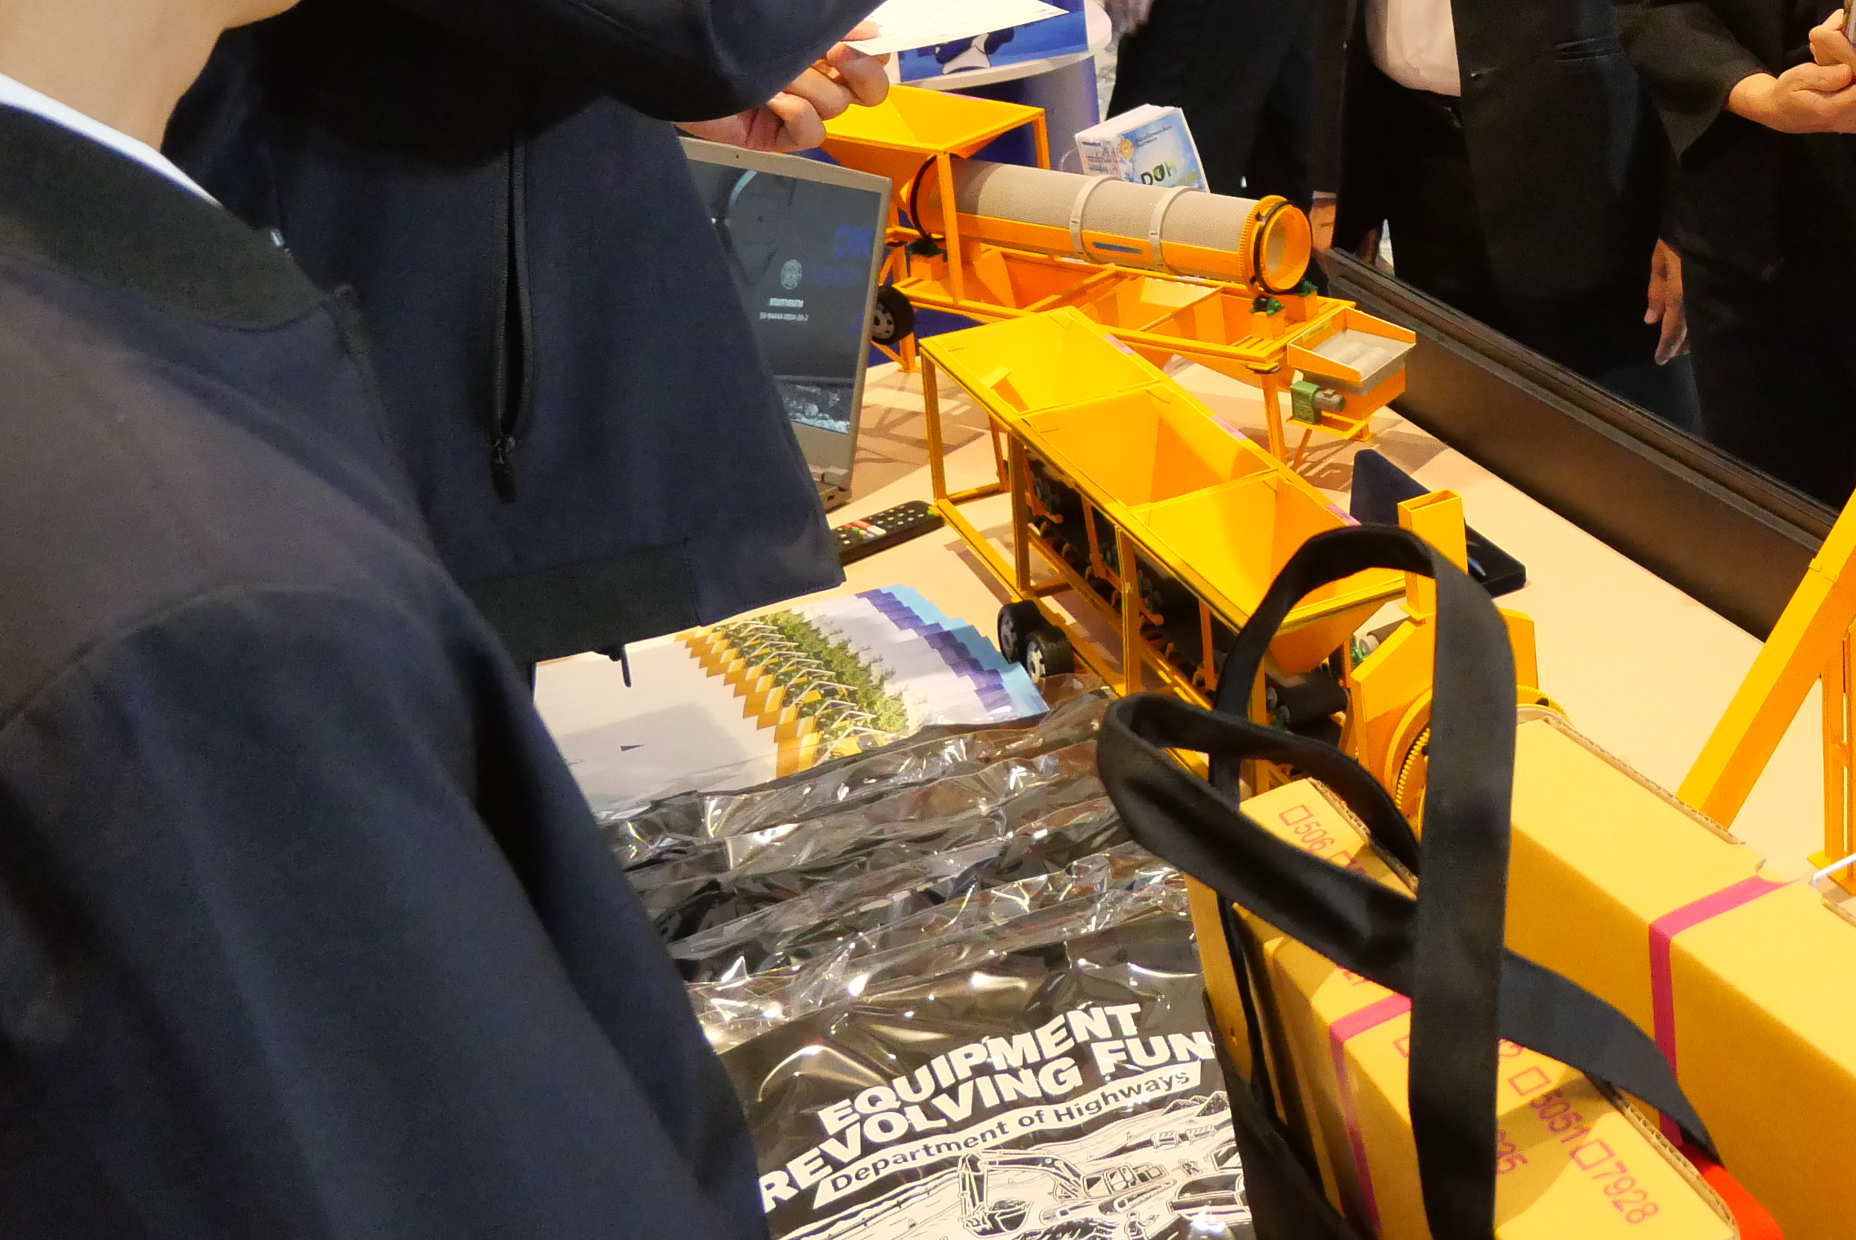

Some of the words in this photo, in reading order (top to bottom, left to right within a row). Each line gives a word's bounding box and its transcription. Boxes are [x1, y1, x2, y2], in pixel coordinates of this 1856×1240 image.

[1293, 820, 1335, 852] 506
[817, 1003, 1142, 1137] EQUIPMENT
[757, 1056, 1084, 1214] REVOLVING
[830, 1118, 1010, 1194] Department
[1017, 1107, 1047, 1127] of
[1053, 1071, 1191, 1124] Highways
[1592, 1160, 1660, 1226] 7928
